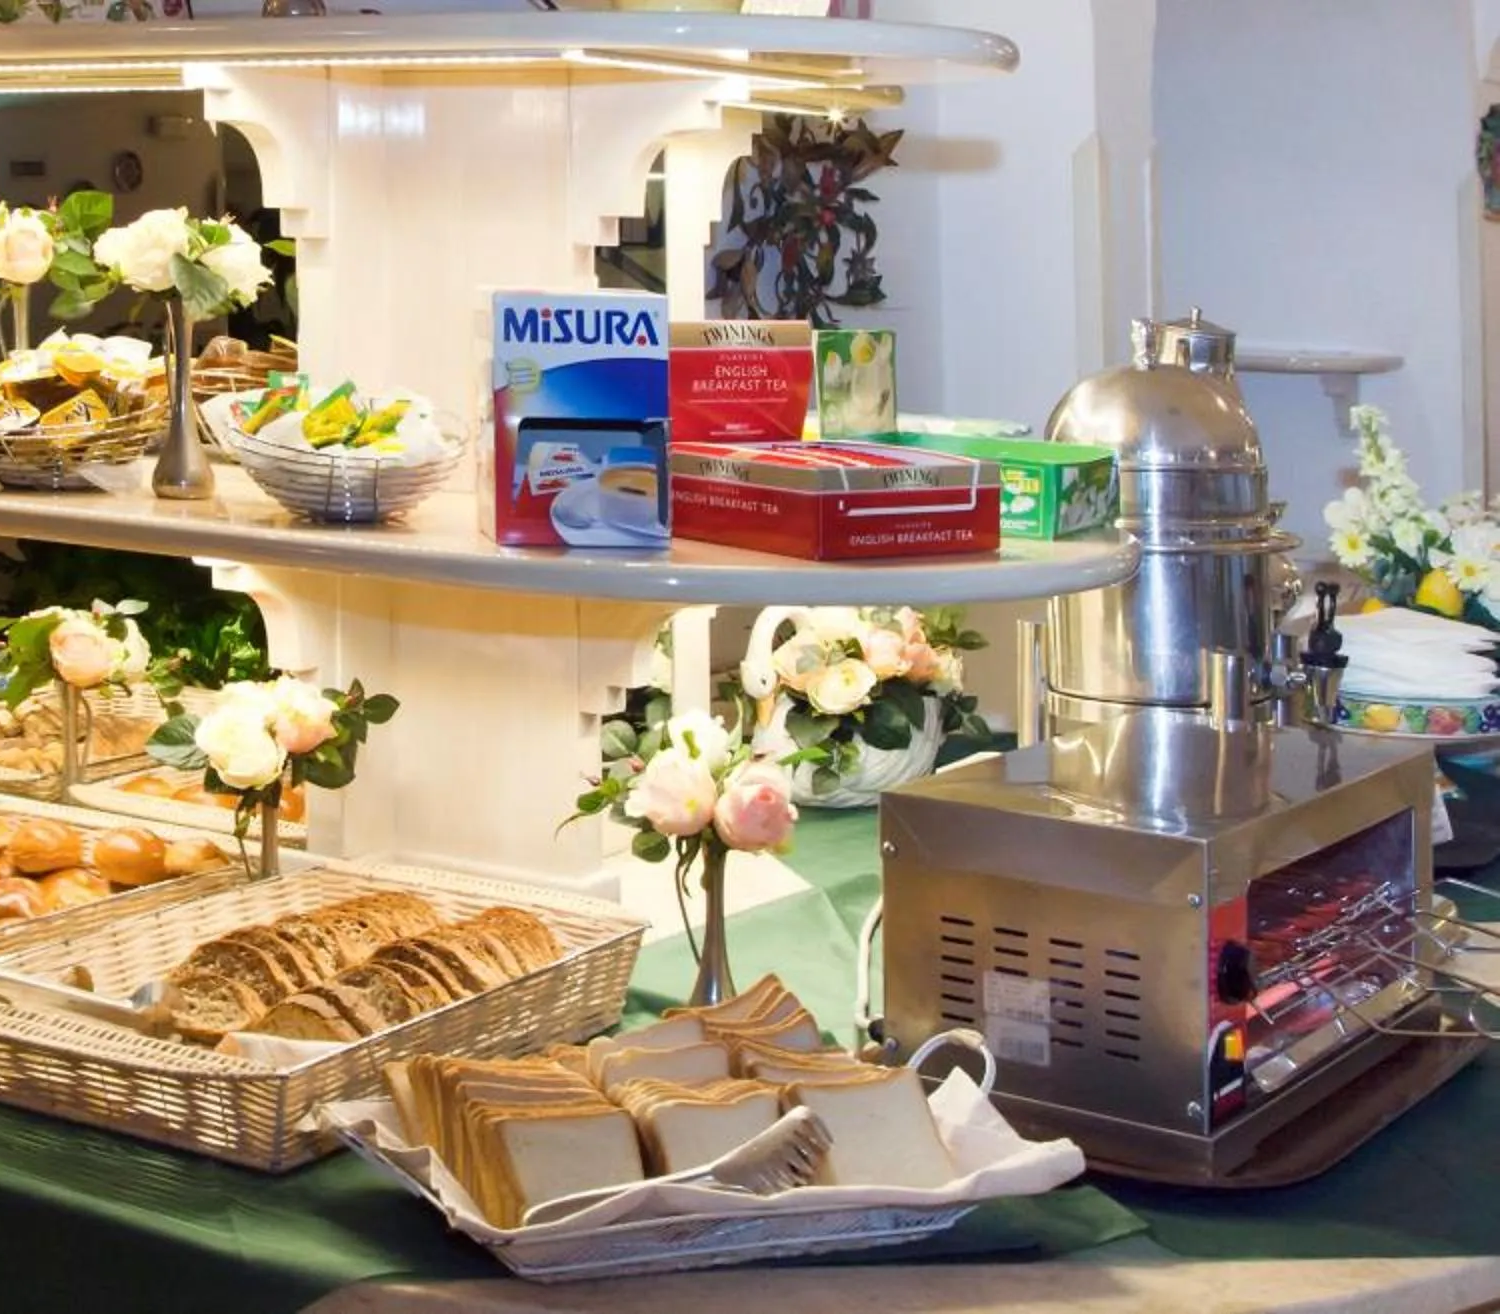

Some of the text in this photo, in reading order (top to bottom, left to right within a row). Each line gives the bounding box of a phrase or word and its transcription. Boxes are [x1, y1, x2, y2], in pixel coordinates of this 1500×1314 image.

[702, 323, 775, 346] TWININGS
[714, 365, 769, 378] ENGLISH
[691, 379, 788, 393] BREAKFAST TEA
[709, 495, 758, 512] BREAKFAST
[762, 503, 779, 515] TEA
[850, 529, 974, 547] ENGLISH BREAKFAST TEA
